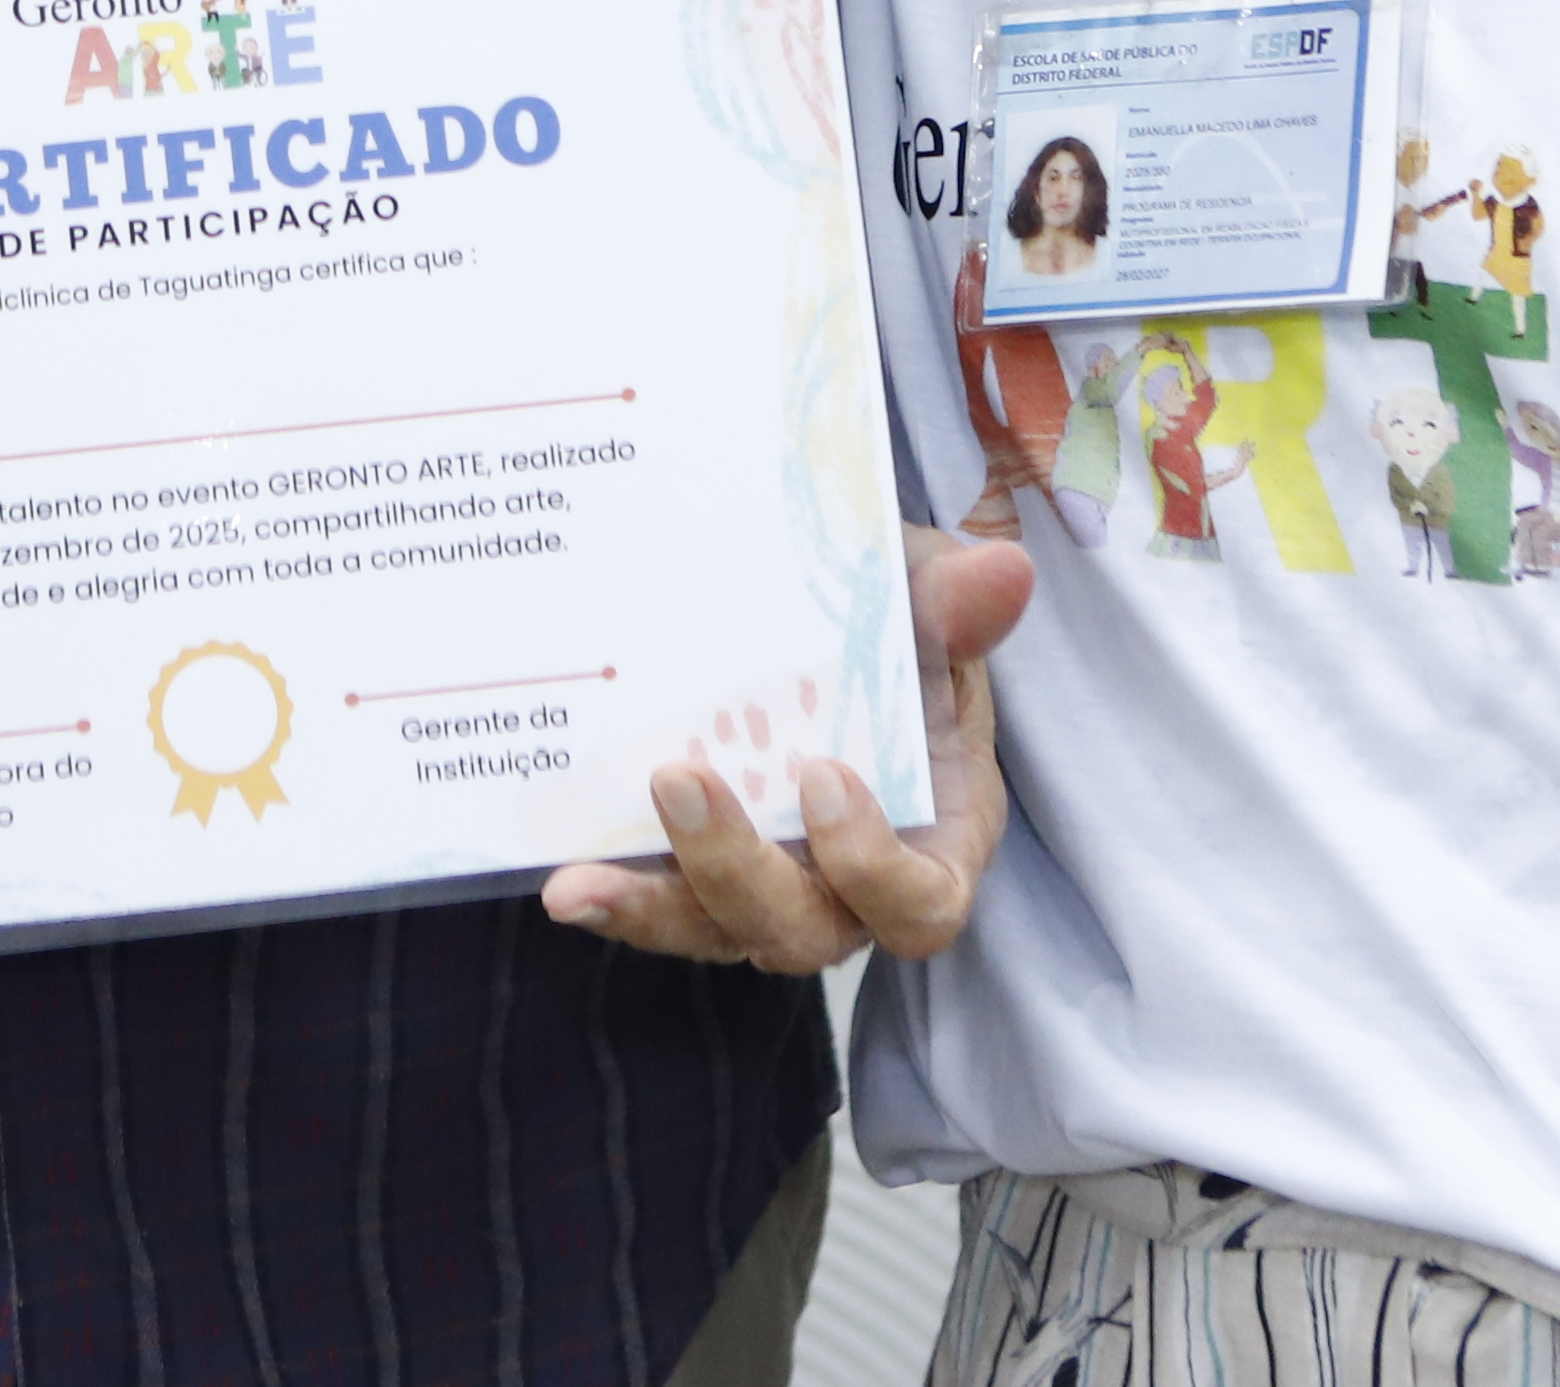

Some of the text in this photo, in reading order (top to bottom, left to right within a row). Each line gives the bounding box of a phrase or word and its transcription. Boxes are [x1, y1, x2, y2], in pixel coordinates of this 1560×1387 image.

[64, 5, 324, 106] ARTE
[1012, 52, 1058, 67] ESCOLA
[1061, 51, 1077, 64] DE
[1251, 27, 1333, 59] ESPDF
[1012, 65, 1123, 85] DISTRITO FEDERAL
[68, 190, 401, 254] PARTICIPAÇÃO
[97, 278, 131, 302] de
[139, 266, 292, 301] Taguatinga
[299, 252, 406, 281] certifica
[413, 249, 464, 276] que
[111, 492, 149, 513] no
[157, 477, 260, 508] evento
[268, 461, 408, 497] GERONTO
[418, 452, 492, 482] ARTE,
[500, 437, 636, 473] realizado
[122, 527, 160, 554] de
[168, 518, 247, 550] 2025,
[254, 493, 497, 541] compartilhando
[504, 487, 571, 515] arte,
[48, 582, 65, 604] e
[74, 567, 179, 604] alegria
[187, 565, 255, 589] com
[263, 552, 333, 581] toda
[342, 553, 361, 573] a
[370, 528, 568, 570] comunidade.
[400, 703, 569, 743] Gerente da
[54, 752, 93, 779] do
[416, 748, 571, 784] Instituição
